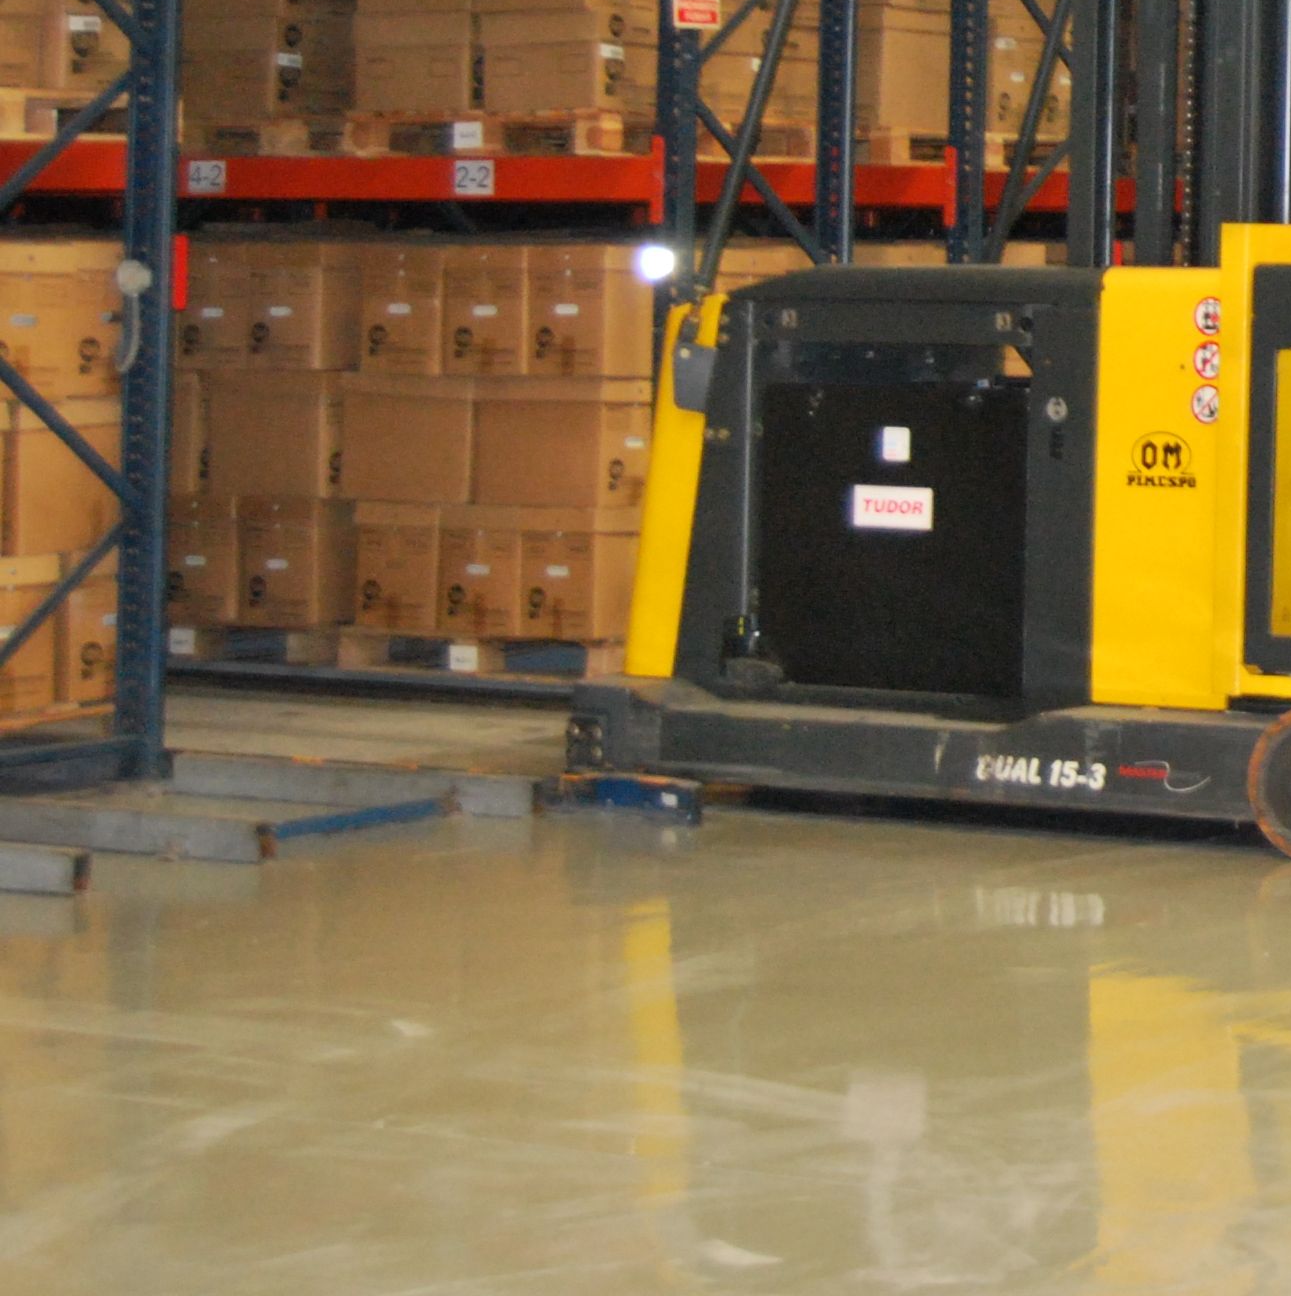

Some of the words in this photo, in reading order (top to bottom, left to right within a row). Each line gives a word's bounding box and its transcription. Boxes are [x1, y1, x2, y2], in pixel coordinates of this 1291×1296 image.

[191, 163, 222, 187] 4-2
[456, 165, 490, 188] 2-2
[1141, 440, 1182, 471] OM
[863, 498, 923, 515] TUDOR
[1050, 758, 1107, 791] 15-3
